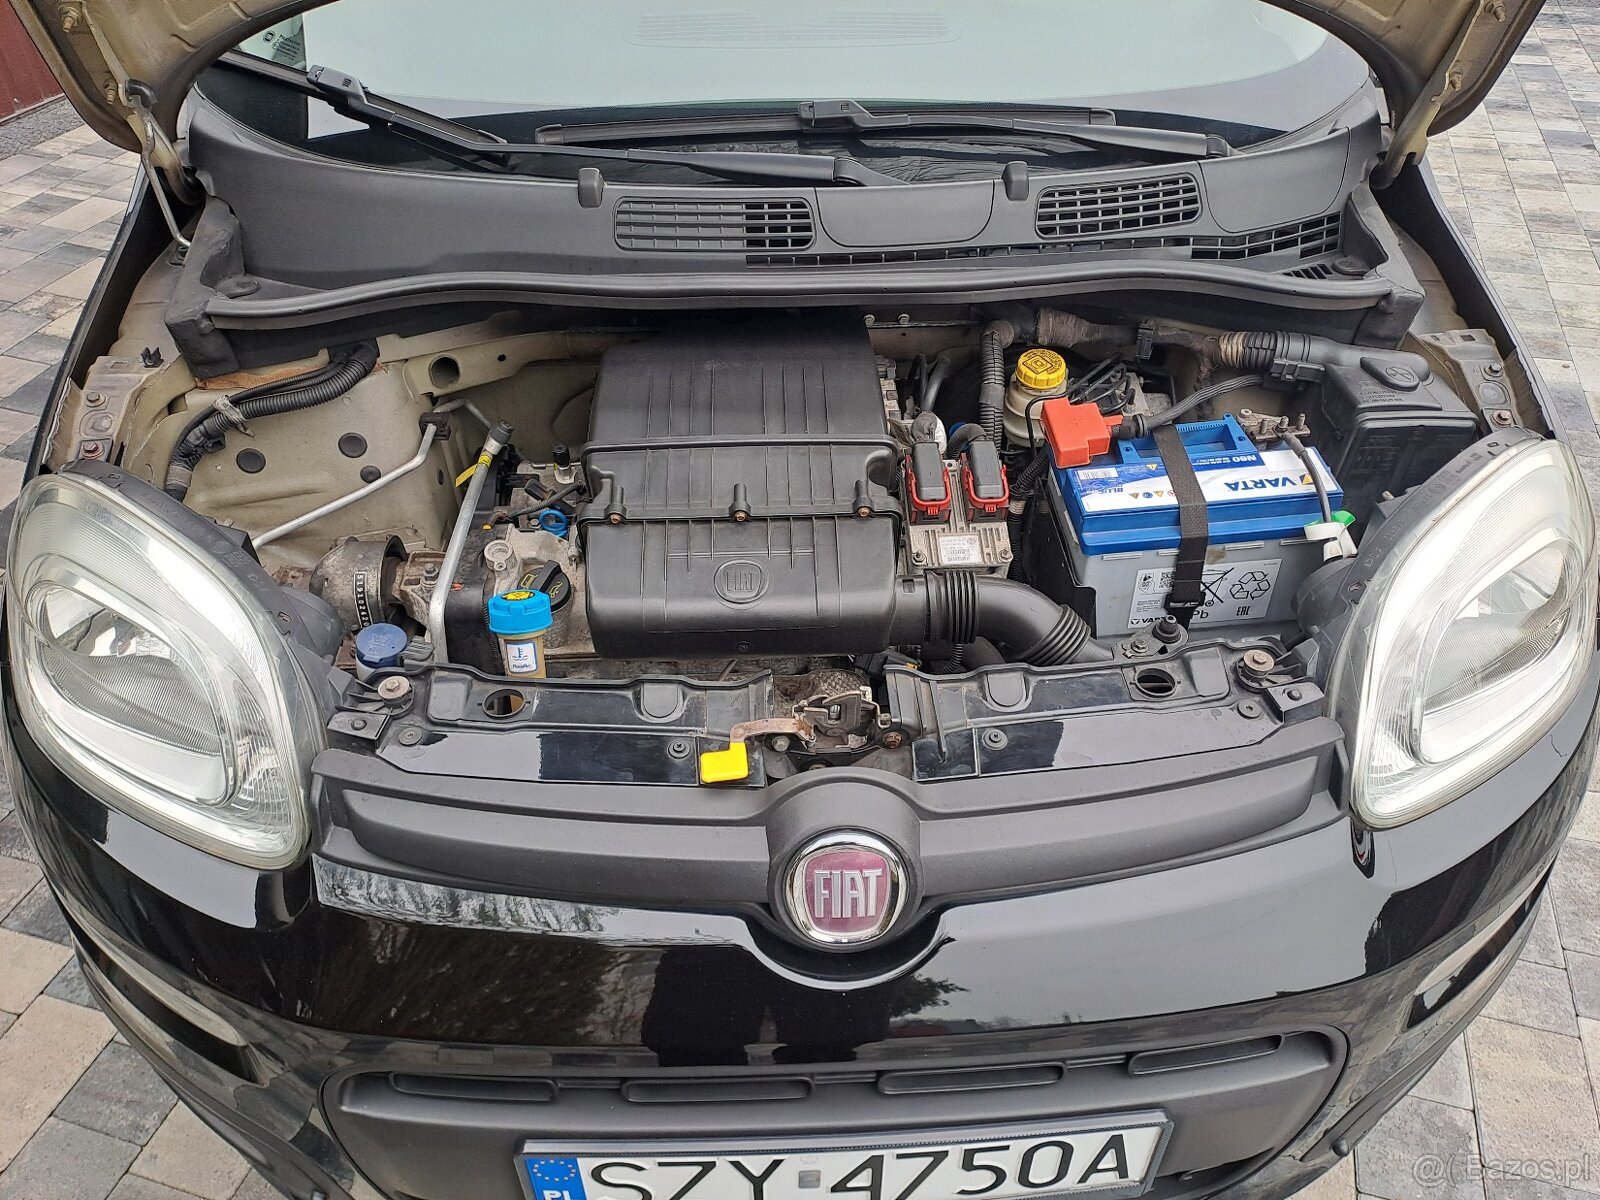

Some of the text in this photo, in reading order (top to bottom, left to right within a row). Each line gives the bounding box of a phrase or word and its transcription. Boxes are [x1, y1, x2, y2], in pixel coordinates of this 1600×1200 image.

[1224, 476, 1297, 492] VARTA
[726, 571, 757, 591] FIAT
[814, 867, 883, 919] FIAT
[591, 1133, 1130, 1200] SZY 4750A
